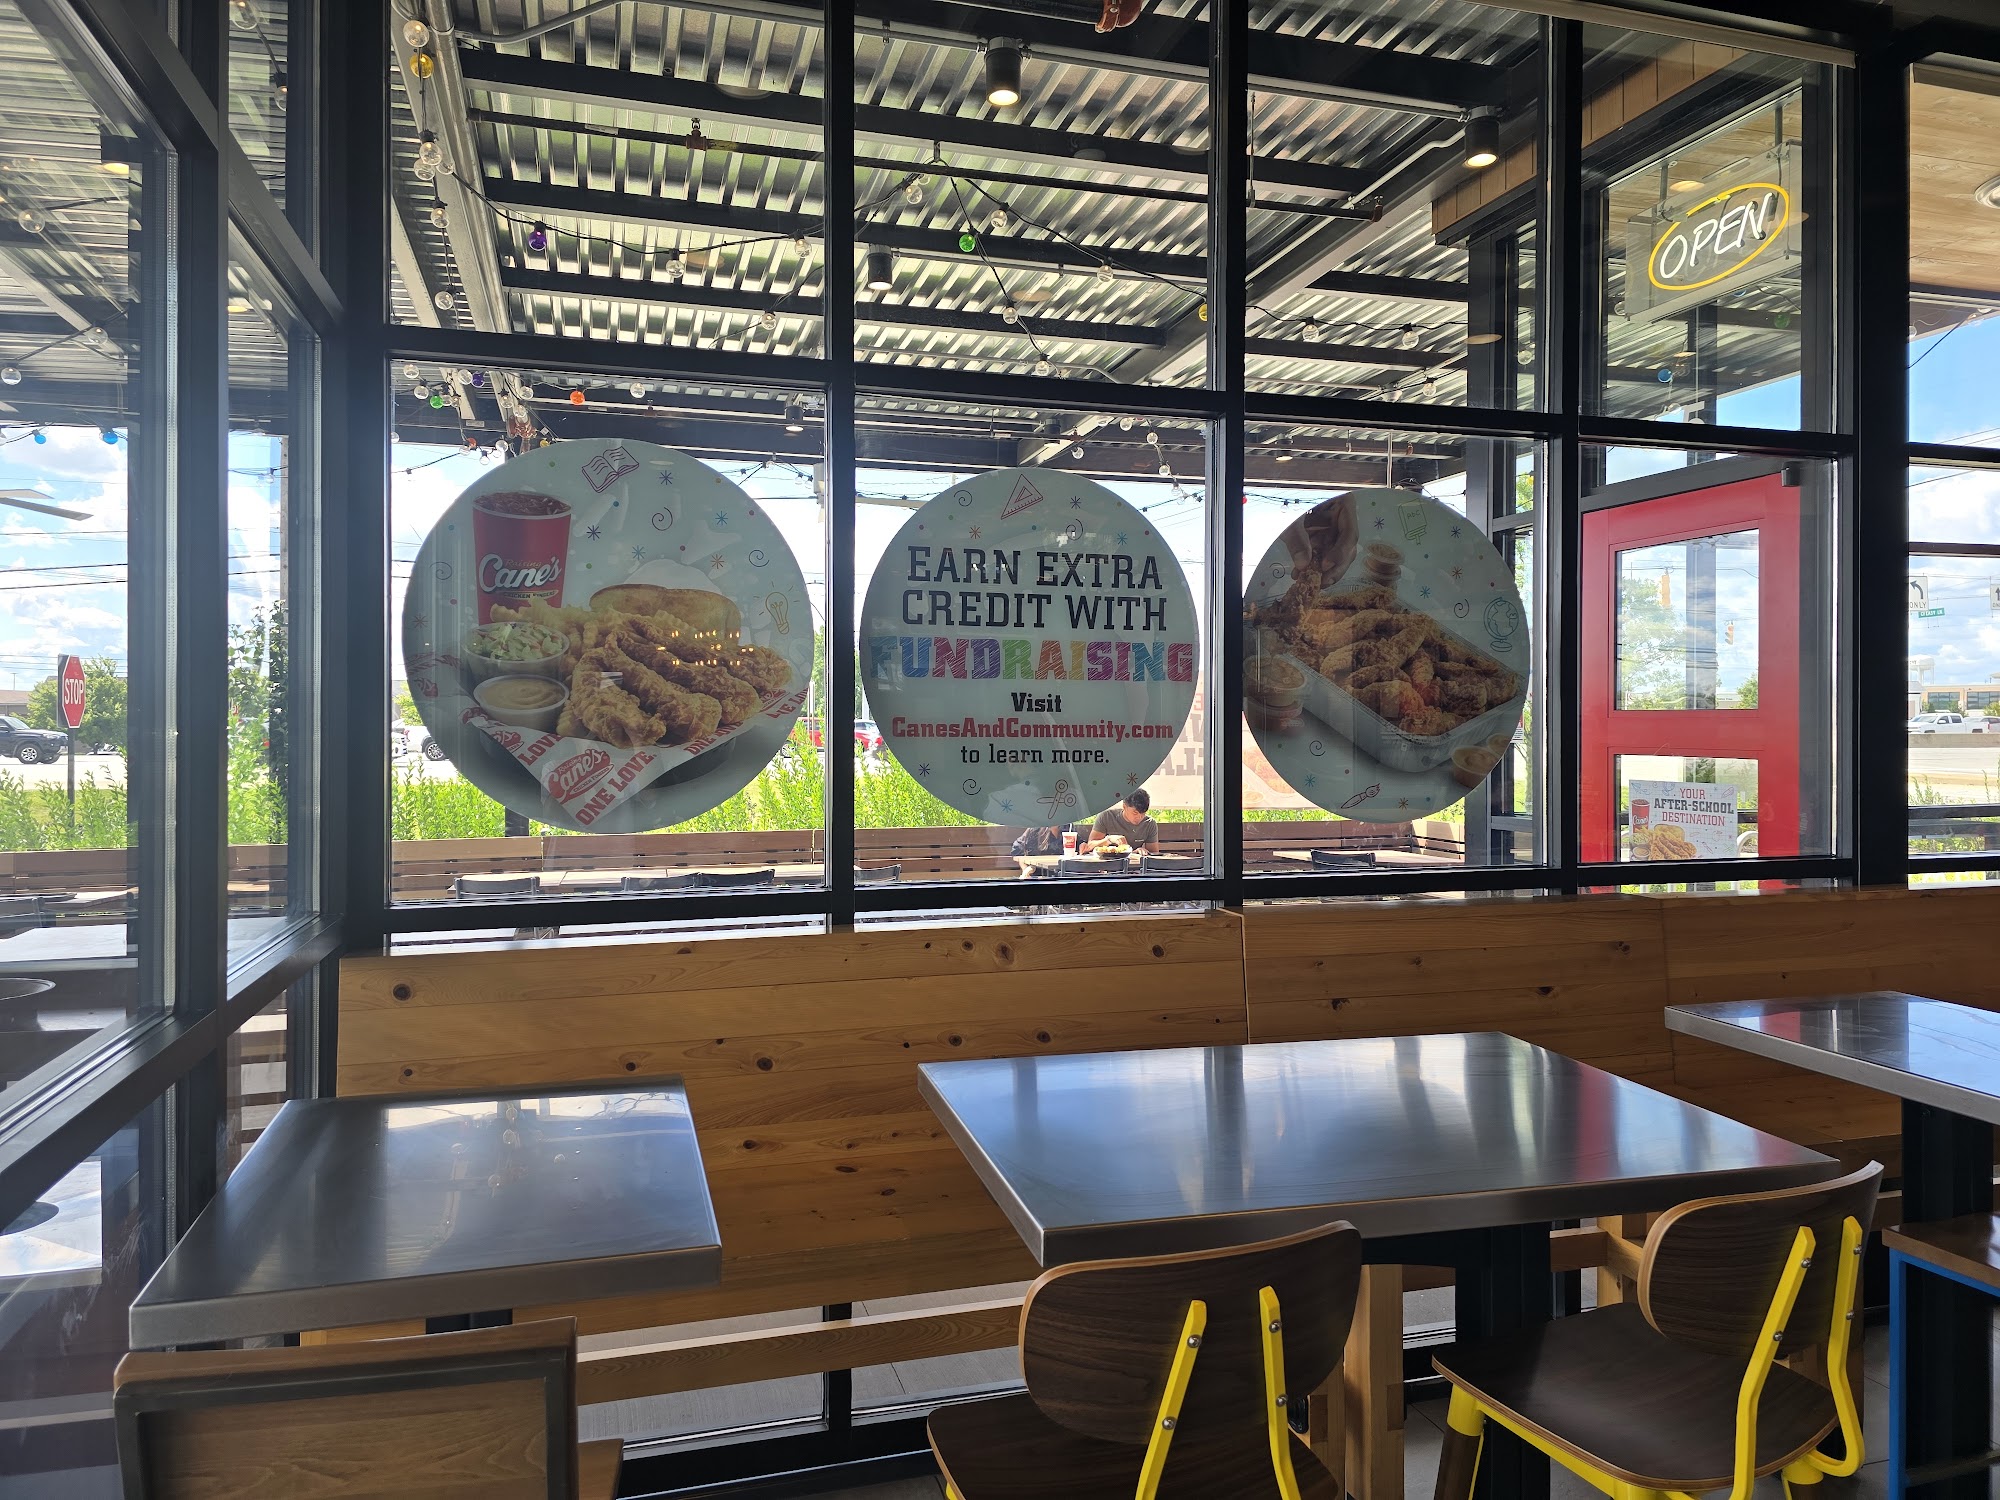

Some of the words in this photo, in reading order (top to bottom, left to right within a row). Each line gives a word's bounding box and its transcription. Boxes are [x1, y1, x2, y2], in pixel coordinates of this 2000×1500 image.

[1660, 192, 1774, 279] OPEN
[478, 553, 562, 593] Cane's
[907, 546, 1020, 585] EARN
[1036, 551, 1163, 590] EXTRA
[902, 590, 1052, 628] CREDIT
[1064, 595, 1167, 632] WITH
[1909, 601, 1927, 609] ONLY
[868, 636, 1193, 683] FUNDRAISING
[64, 678, 84, 705] STOP
[1011, 692, 1062, 713] Visit
[892, 716, 1174, 743] CanesAndCommunity.com
[961, 746, 980, 764] to
[989, 743, 1044, 764] learn
[1052, 749, 1110, 764] more.
[547, 748, 606, 804] Cane's
[575, 787, 617, 826] ONE
[607, 750, 658, 793] LOVE.
[1653, 798, 1734, 815] AFTER-SCHOOL
[1679, 788, 1706, 800] YOUR
[1661, 811, 1726, 827] DESTINATION
